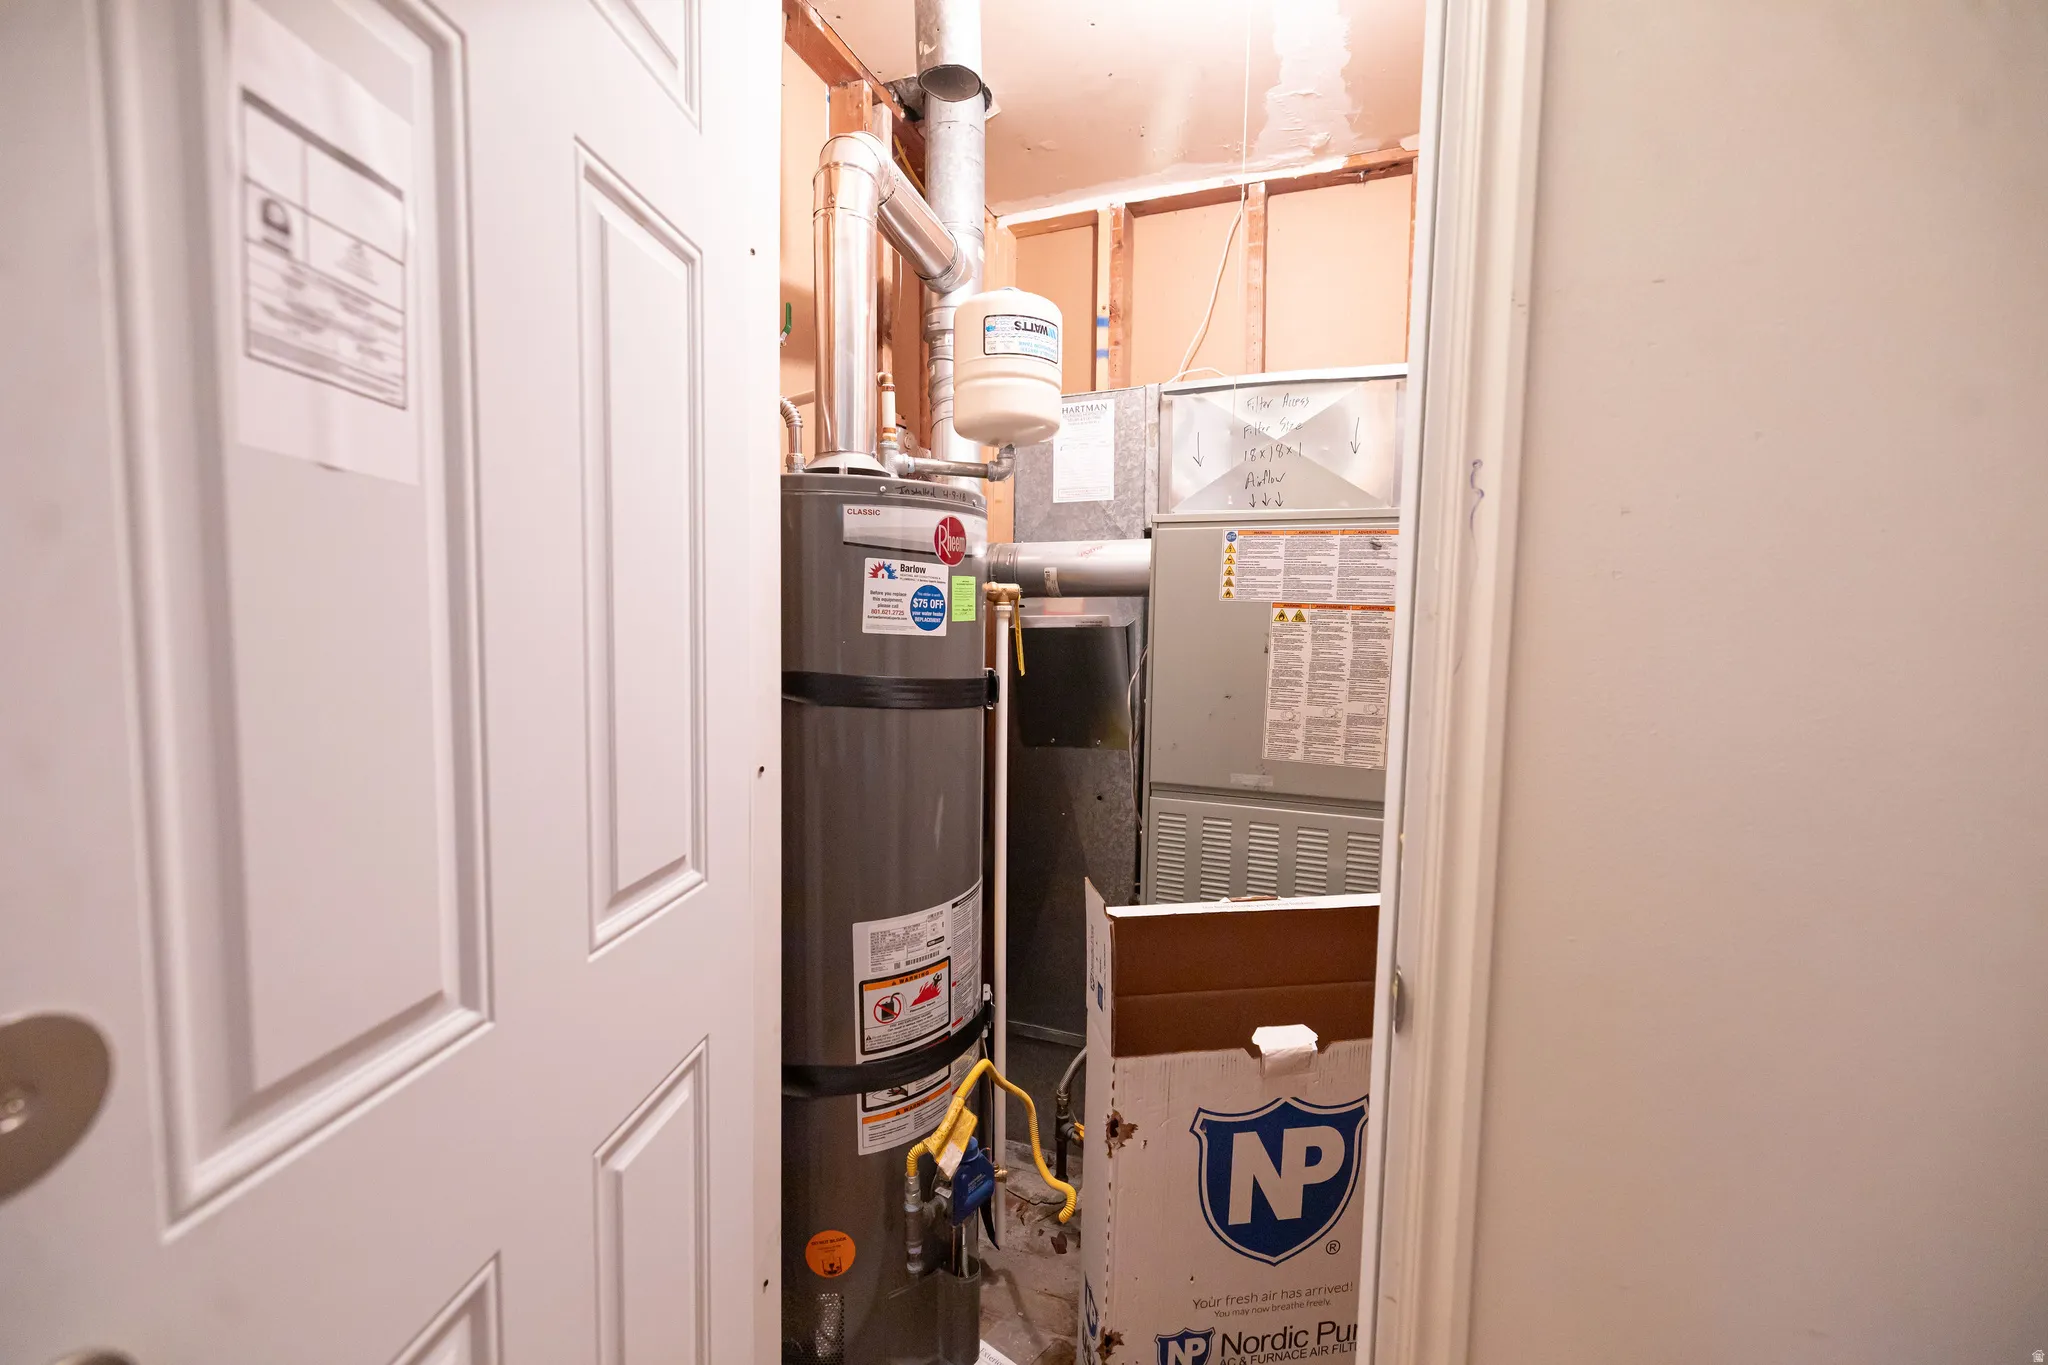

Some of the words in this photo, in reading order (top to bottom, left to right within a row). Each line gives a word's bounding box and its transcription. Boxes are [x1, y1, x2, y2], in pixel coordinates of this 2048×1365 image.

[1014, 320, 1049, 336] WATTS
[1061, 402, 1107, 415] HARTMAN
[1247, 396, 1273, 412] Filter
[1282, 392, 1309, 408] Access
[1280, 416, 1303, 432] Size
[1245, 470, 1286, 490] Airflow
[895, 485, 936, 498] Installed
[846, 508, 880, 516] CLASSIC
[938, 517, 965, 559] Rheem
[900, 563, 926, 574] Barlow
[913, 598, 928, 608] $75
[930, 599, 943, 609] OFF
[899, 970, 930, 985] WARNING
[1228, 1125, 1346, 1226] NP
[1192, 1297, 1221, 1309] Your
[1225, 1292, 1258, 1306] fresh
[1261, 1290, 1278, 1302] air
[1281, 1288, 1302, 1300] has
[1305, 1281, 1353, 1297] arrived!
[1214, 1310, 1230, 1318] You
[1232, 1308, 1250, 1316] may
[1251, 1304, 1270, 1314] now
[1271, 1300, 1305, 1312] breathe
[1306, 1298, 1331, 1308] freely.
[1166, 1336, 1207, 1365] NP
[1221, 1325, 1309, 1357] Nordic
[1250, 1348, 1308, 1365] FURNACE
[1309, 1345, 1330, 1358] AIR
